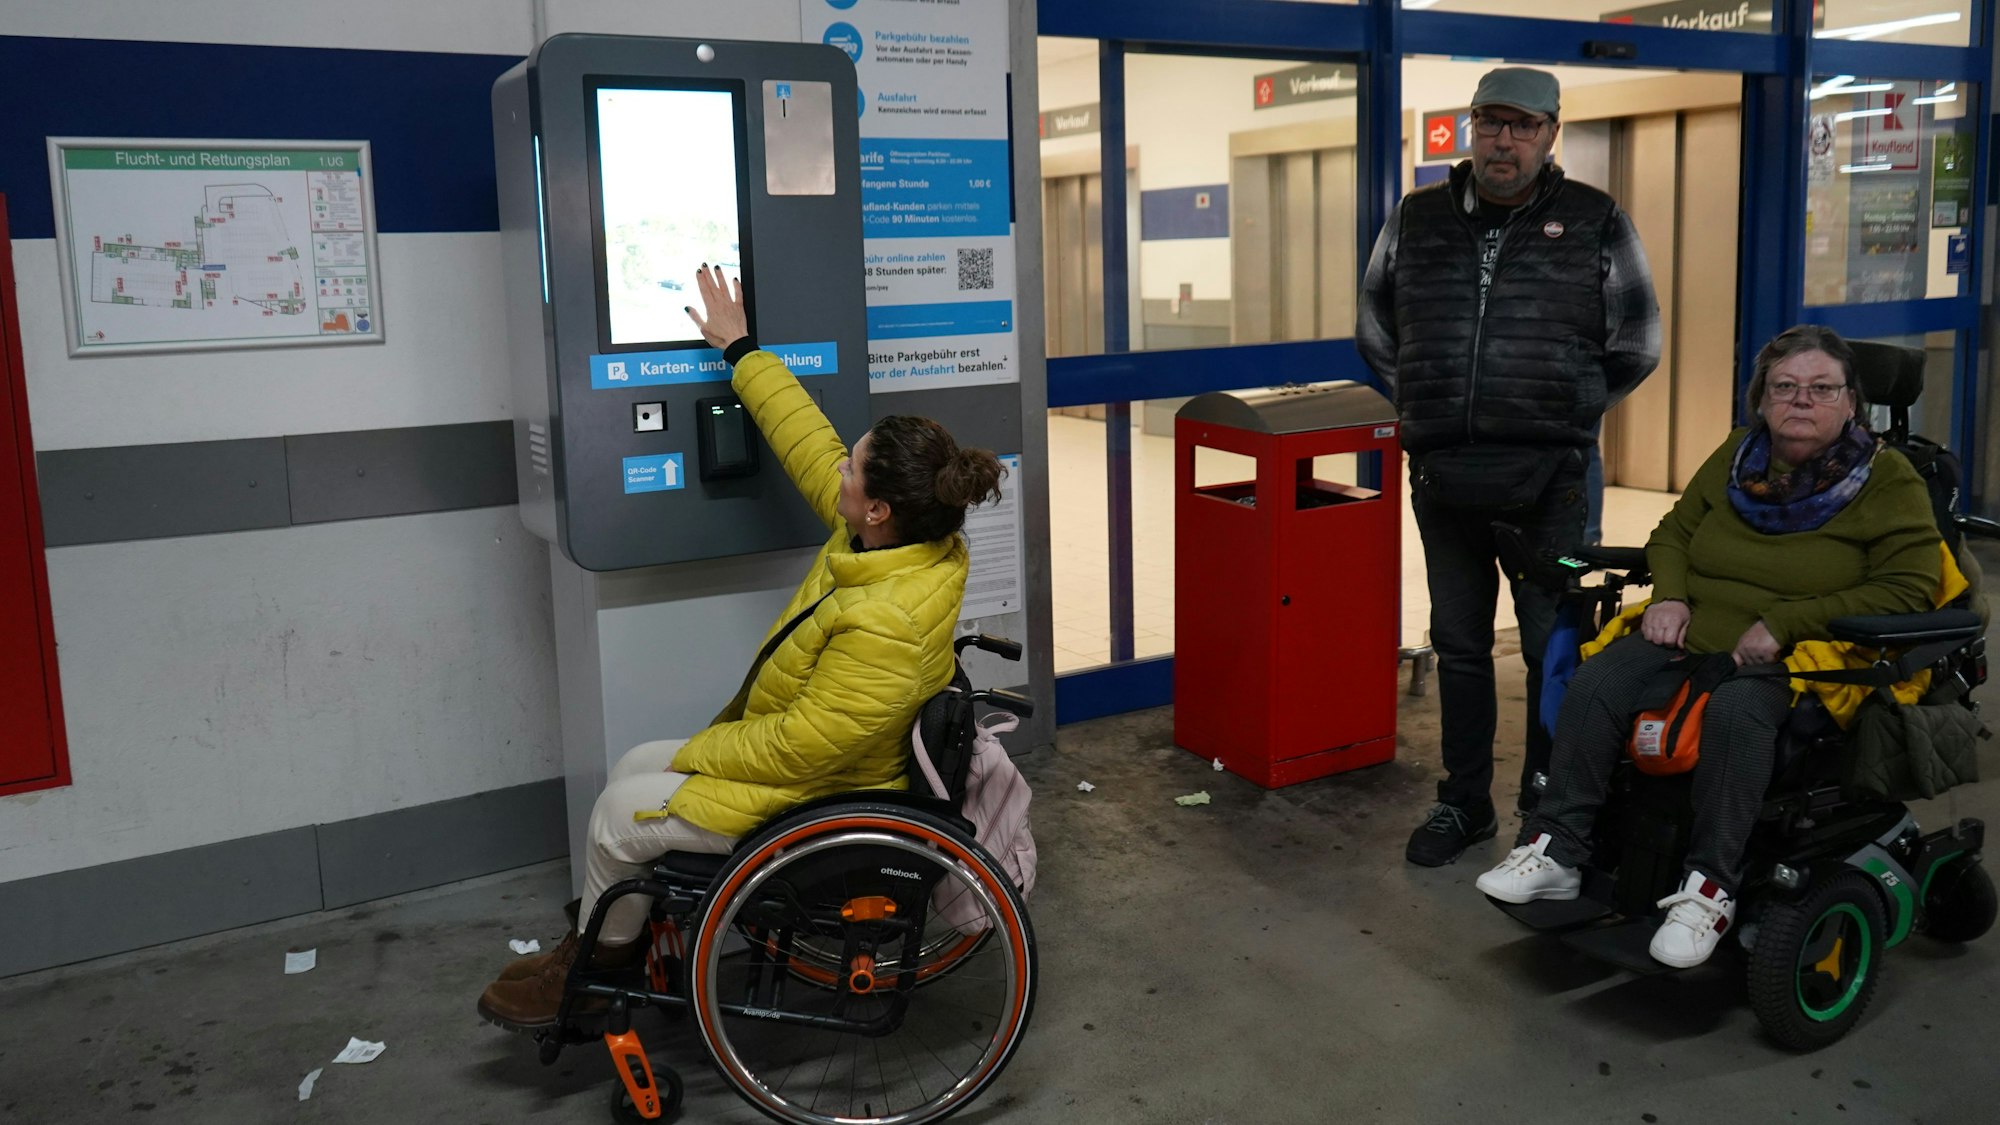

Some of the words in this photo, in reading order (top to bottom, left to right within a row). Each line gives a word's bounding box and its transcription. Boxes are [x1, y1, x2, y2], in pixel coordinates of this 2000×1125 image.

[1662, 1, 1749, 30] Verkauf
[875, 31, 927, 43] Parkgebühr
[929, 34, 970, 44] bezahlen
[903, 46, 933, 54] Ausfahrt
[946, 58, 967, 67] Handy
[1290, 70, 1340, 95] Verkauf
[878, 92, 917, 102] Ausfahrt
[923, 107, 939, 115] wird
[1055, 111, 1089, 131] Verkauf
[1872, 139, 1914, 153] Kaufland
[115, 152, 165, 166] Flucht-
[169, 153, 195, 166] und
[201, 153, 290, 169] Rettungsplan
[899, 179, 929, 188] Stunde
[969, 179, 985, 189] 1,00
[986, 179, 991, 188] €
[863, 202, 925, 211] ufland-Kunden
[927, 203, 952, 211] parken
[955, 202, 979, 210] mittels
[892, 215, 903, 223] 90
[905, 215, 940, 223] Minuten
[887, 252, 914, 263] online
[917, 252, 946, 262] zahlen
[876, 266, 914, 276] Stunden
[917, 266, 947, 277] später:
[868, 353, 894, 364] Bitte
[897, 349, 957, 363] Parkgebühr
[960, 348, 980, 358] erst
[640, 361, 695, 376] Karten-
[699, 359, 726, 372] und
[868, 371, 885, 379] vor
[889, 368, 907, 378] der
[910, 365, 955, 377] Ausfahrt
[958, 361, 1006, 373] bezahlen.
[627, 466, 657, 475] QR-Code
[1880, 870, 1900, 887] F5
